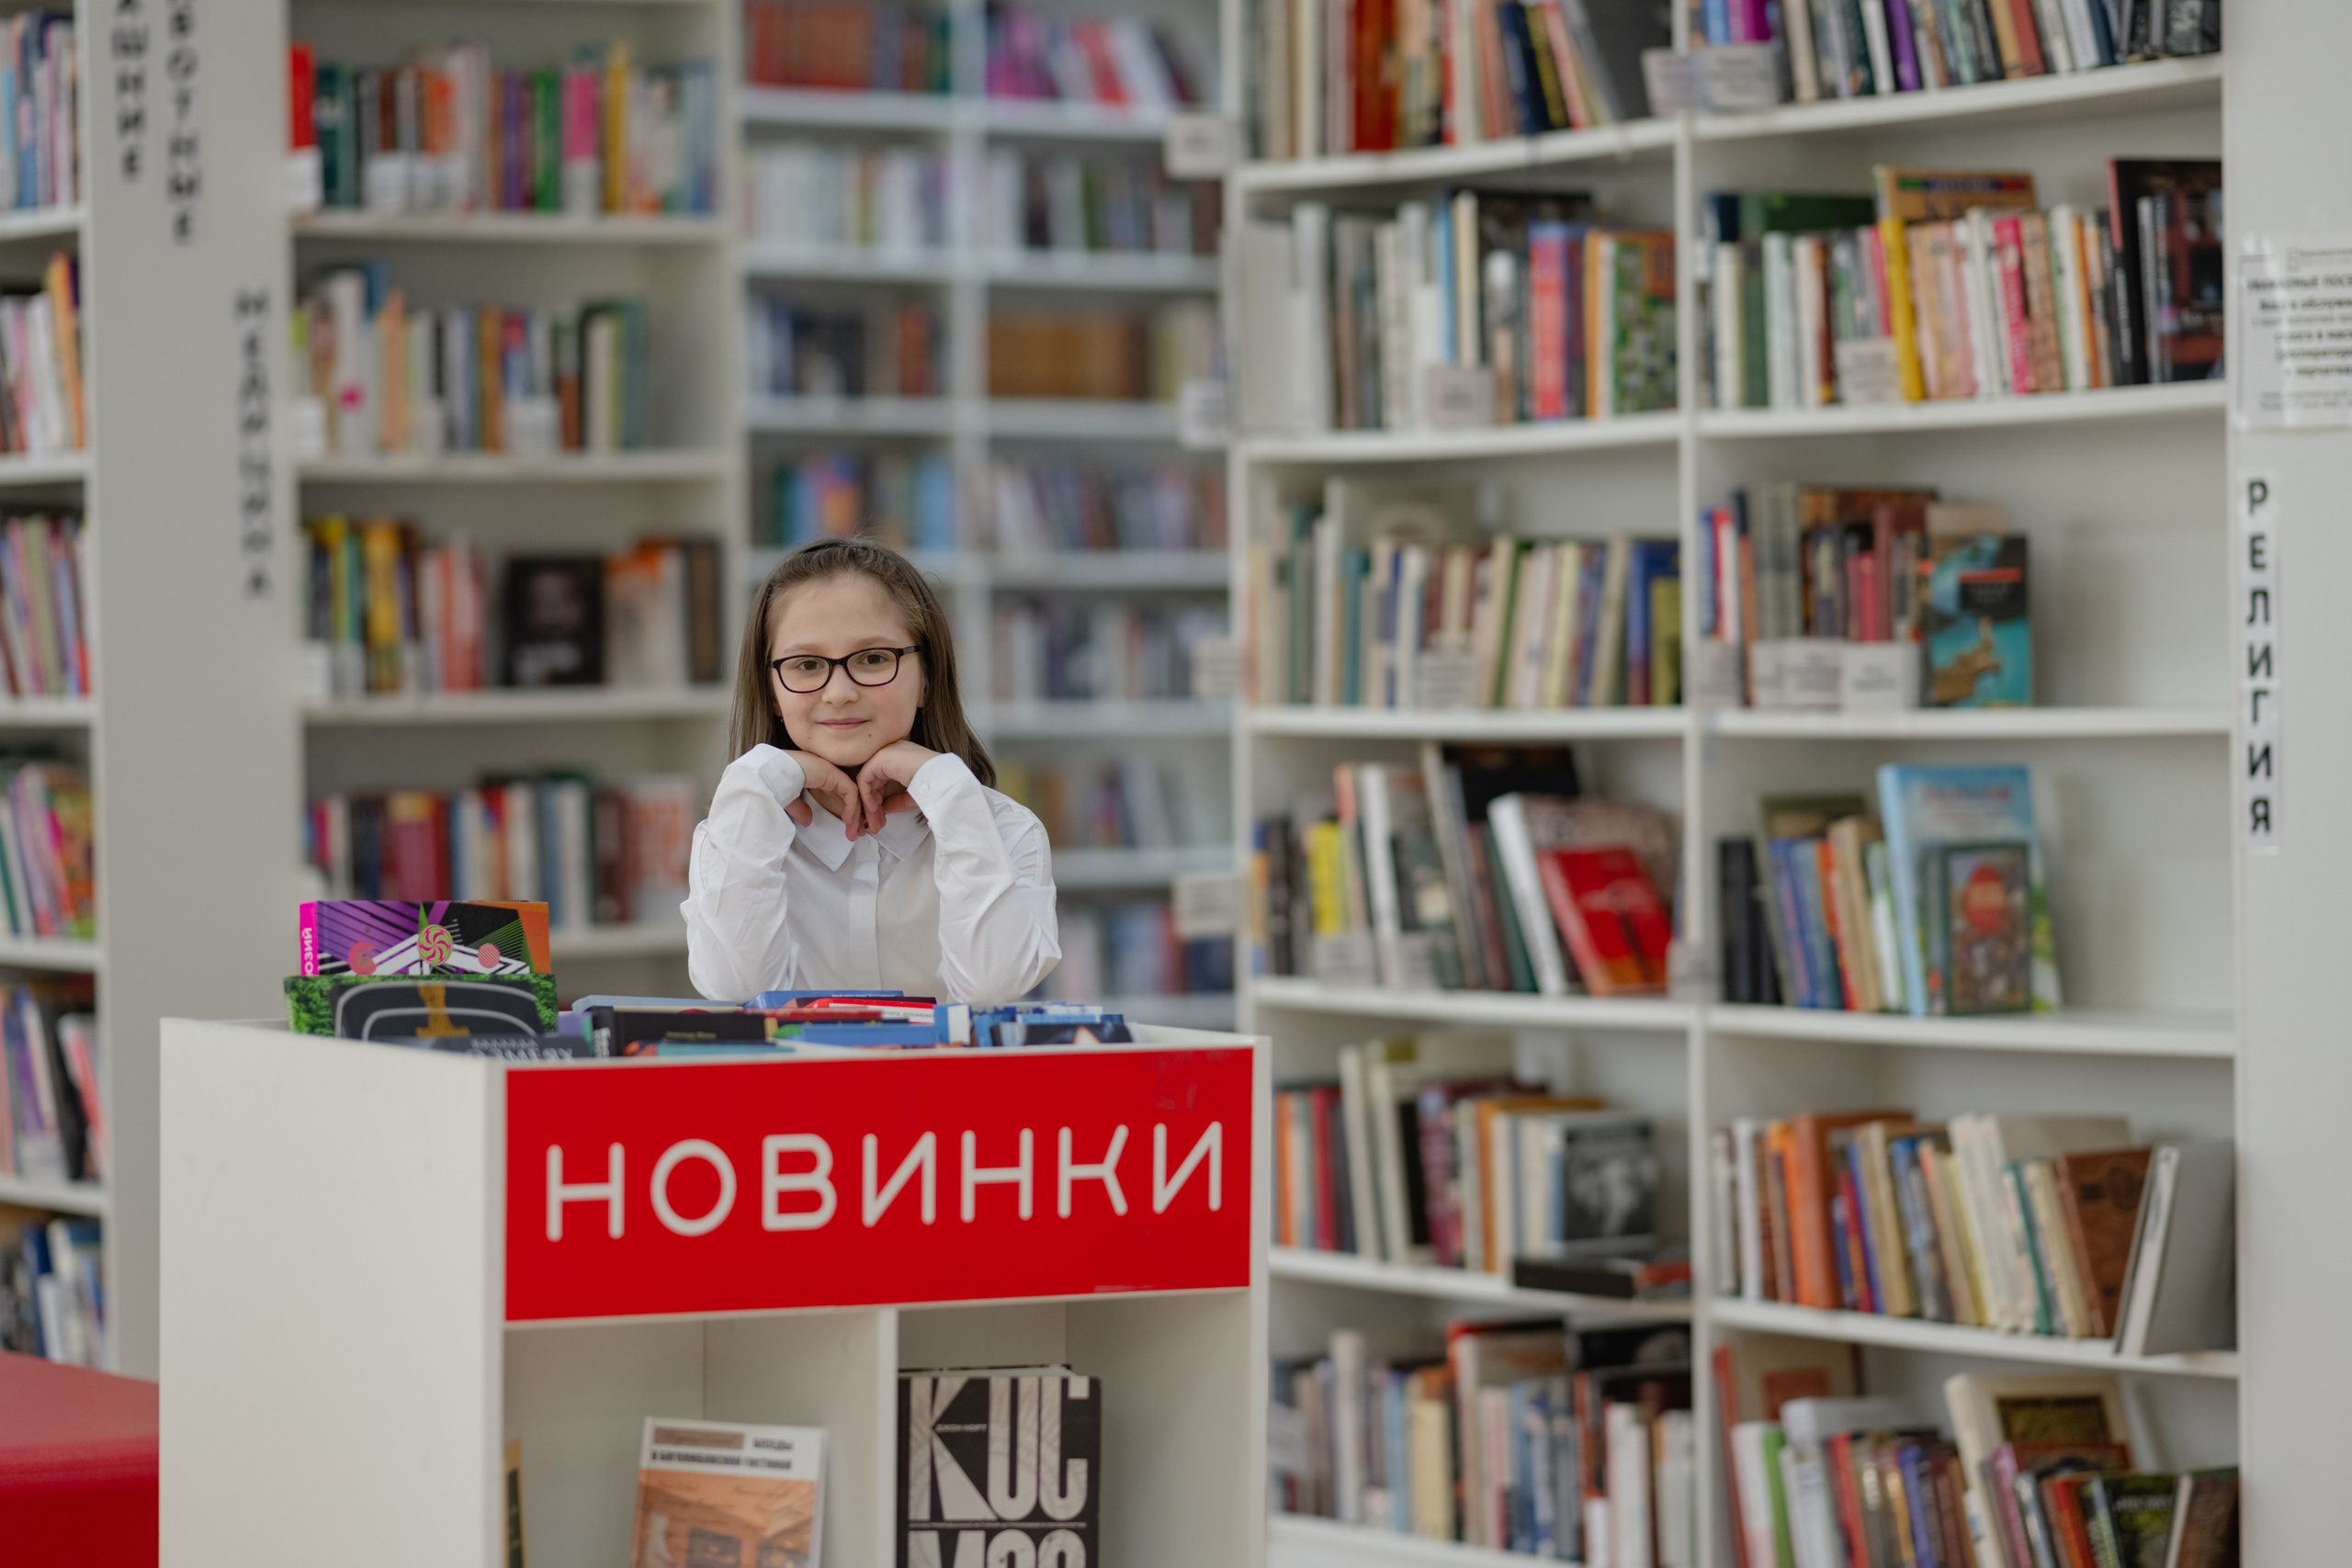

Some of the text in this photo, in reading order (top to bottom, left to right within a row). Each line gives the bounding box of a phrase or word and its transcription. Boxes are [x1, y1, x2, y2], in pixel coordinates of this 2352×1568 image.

[166, 0, 201, 244] ВОТНЫЕ
[2246, 479, 2273, 834] РЕЛИГИЯ
[546, 1121, 1223, 1242] НОВИНКИ
